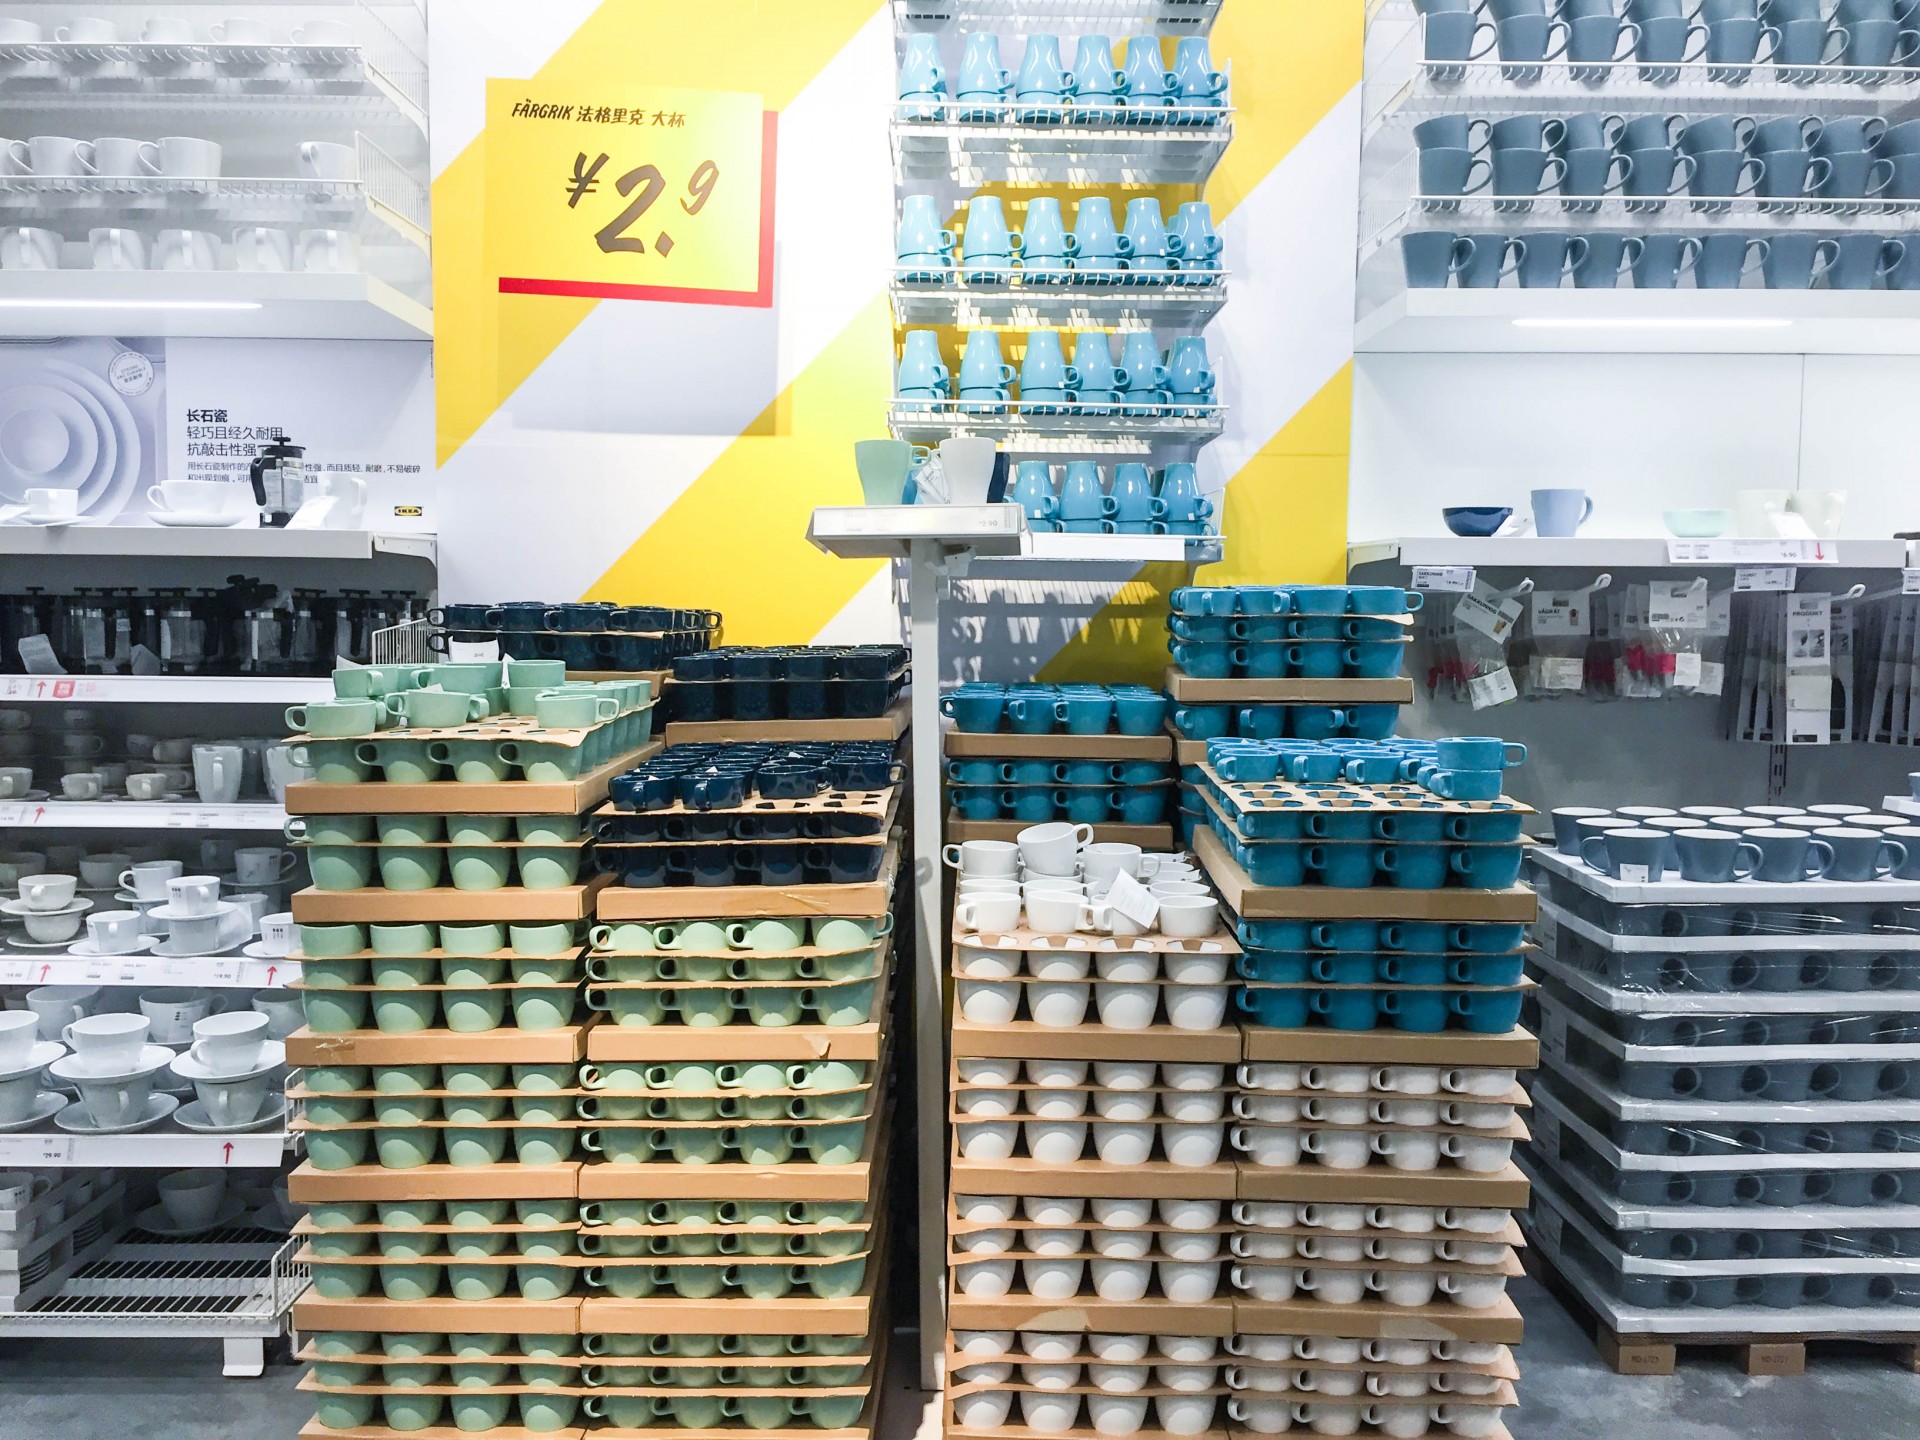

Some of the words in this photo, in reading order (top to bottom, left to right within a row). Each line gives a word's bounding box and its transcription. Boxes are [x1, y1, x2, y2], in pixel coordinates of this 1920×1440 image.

[511, 98, 574, 120] FÄRGRIK
[576, 105, 646, 126] 法格里克
[651, 111, 687, 128] 大杯
[186, 408, 228, 423] 长石瓷
[187, 425, 283, 441] 轻巧且经久耐用
[187, 442, 257, 457] 抗敲击性强
